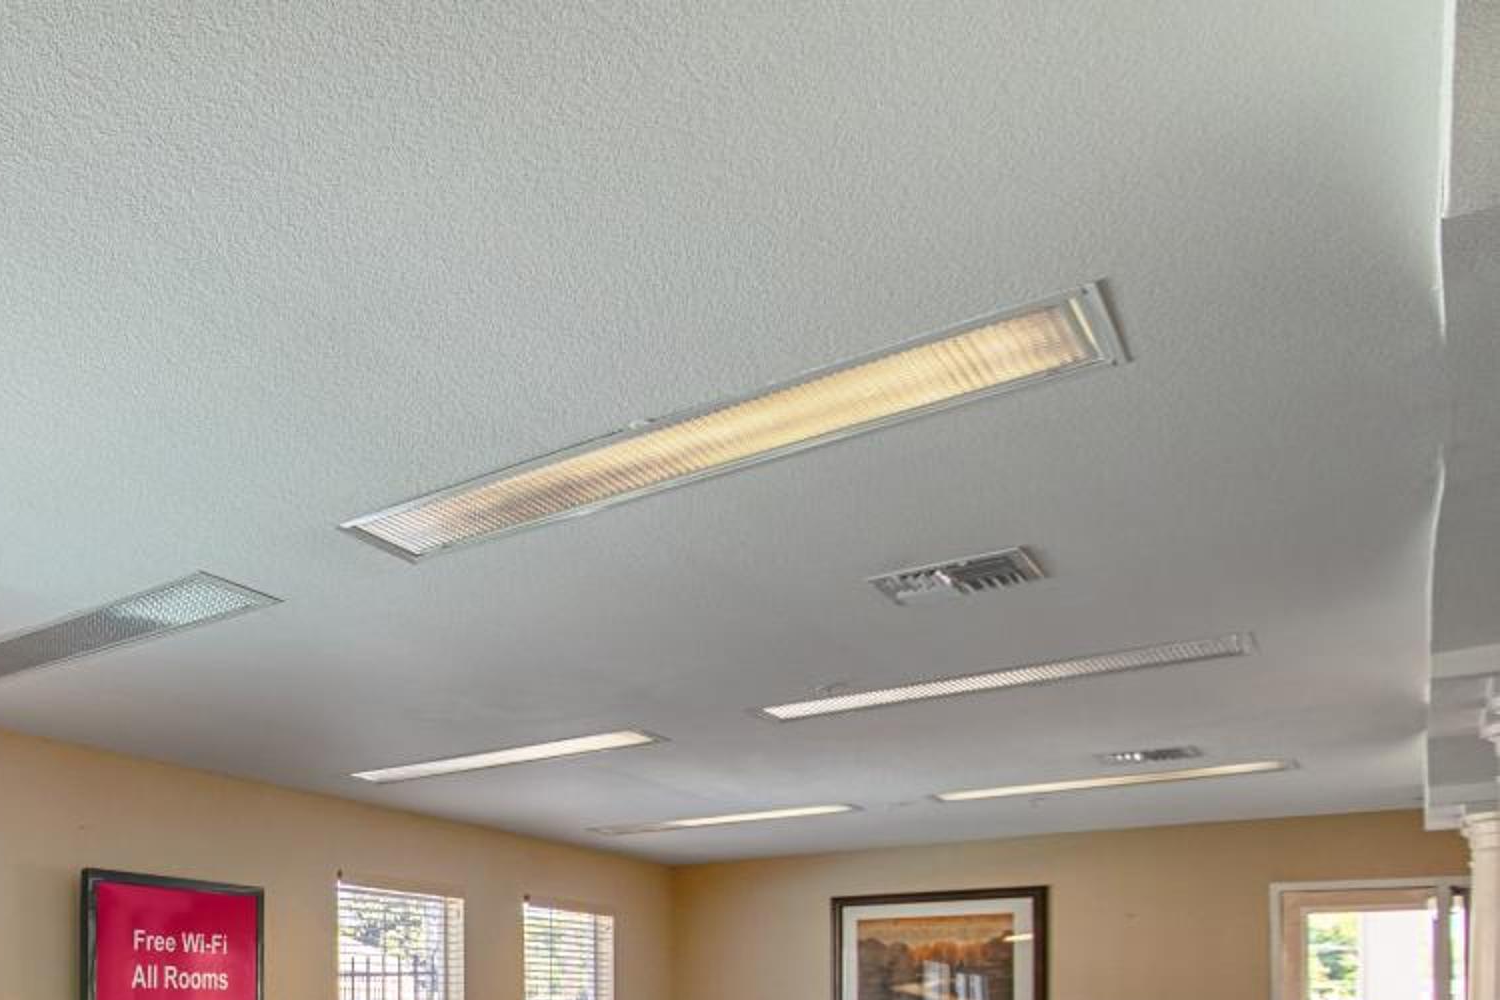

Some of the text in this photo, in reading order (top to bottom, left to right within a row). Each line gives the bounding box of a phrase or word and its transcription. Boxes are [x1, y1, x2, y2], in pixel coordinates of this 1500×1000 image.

[133, 929, 228, 955] Free Wi-Fi
[131, 964, 229, 991] All Rooms
